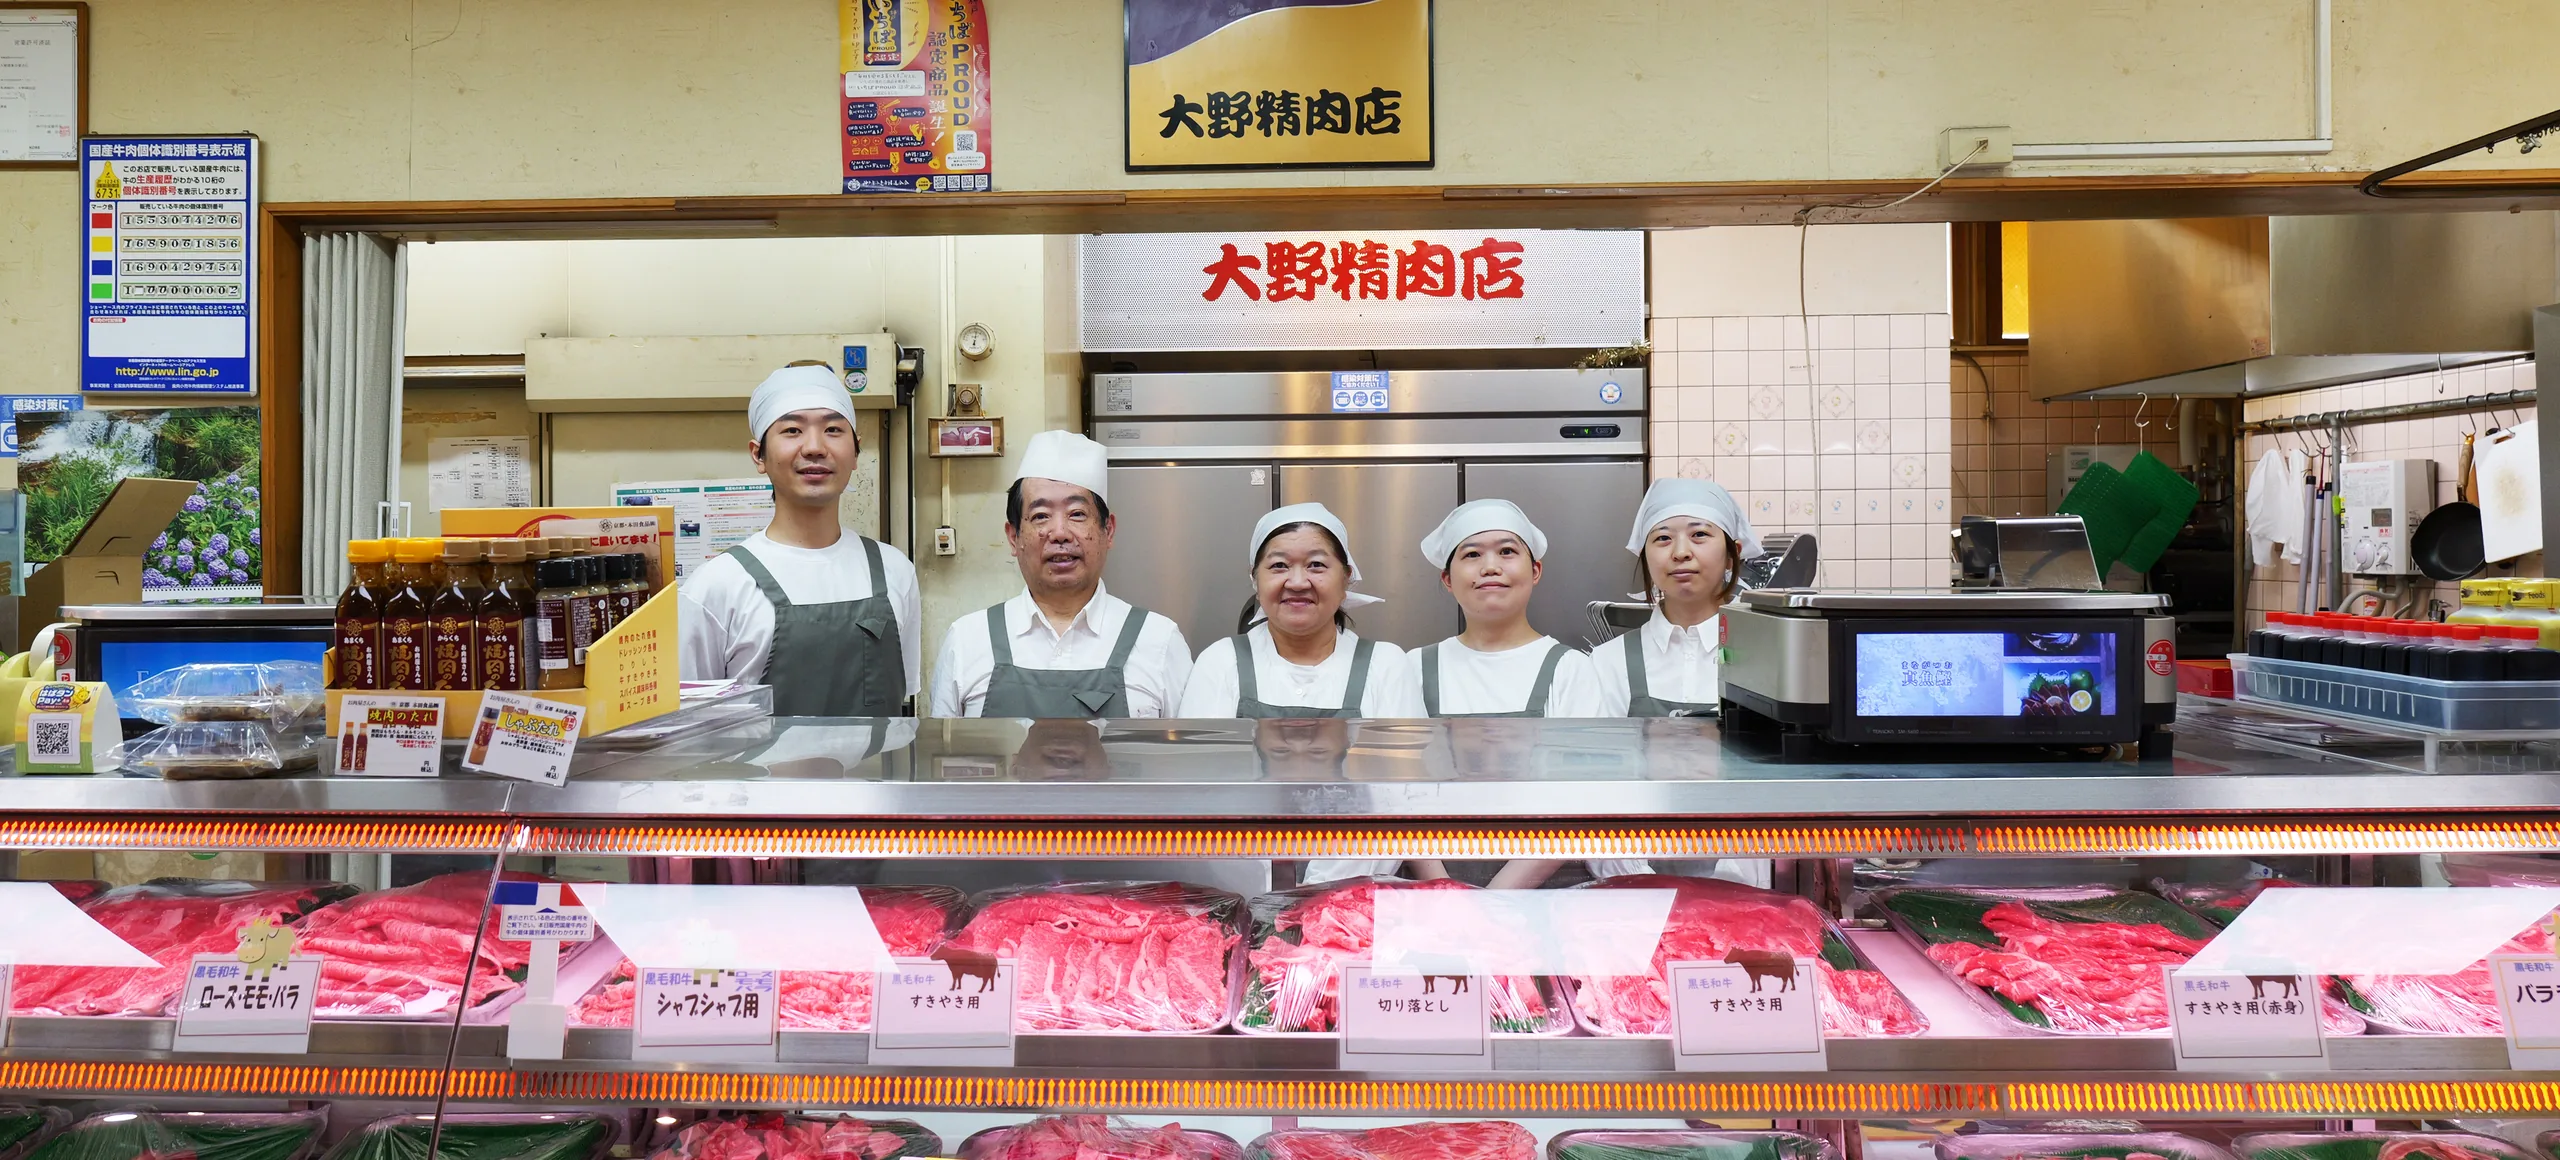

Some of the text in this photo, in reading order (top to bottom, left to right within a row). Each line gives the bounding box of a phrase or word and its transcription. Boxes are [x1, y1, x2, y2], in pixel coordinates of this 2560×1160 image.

[1158, 87, 1402, 139] 大野精肉店
[89, 143, 246, 158] 国産牛肉個体識別番号表示板
[122, 165, 244, 173] このお店で販売している国産牛肉には、
[122, 174, 225, 185] 牛の生産履歴がわかる10桁の
[122, 186, 243, 196] 個体識別番号を表示しております。
[1202, 238, 1525, 302] 大野精肉店
[115, 367, 219, 377] http://www.lin.go.jp
[12, 398, 69, 410] 感染対策に
[344, 636, 364, 644] あまくち
[392, 636, 413, 644] あまくち
[437, 634, 460, 642] からくち
[485, 634, 508, 642] からくち
[365, 646, 373, 684] お肉屋さんの
[460, 644, 468, 683] お肉屋さんの
[508, 644, 516, 683] お肉屋さんの
[1901, 660, 1953, 670] まながつお
[368, 708, 434, 723] 焼肉のたれ
[504, 713, 561, 737] しゃぶたれ
[194, 965, 240, 979] 黒毛和牛
[2513, 961, 2555, 972] 黒毛和牛
[645, 972, 693, 986] 黒毛和牛
[735, 970, 773, 978] ロース
[892, 973, 936, 985] 黒毛和牛
[1358, 977, 1403, 989] 黒毛和牛
[1688, 977, 1733, 990] 黒毛和牛
[2184, 980, 2231, 992] 黒毛和牛
[200, 984, 300, 1010] ロース・モモ・バラ
[2516, 983, 2560, 1003] バラ
[657, 992, 759, 1019] シャブシャブ用
[910, 994, 980, 1010] すきやき用
[1377, 998, 1450, 1013] 切り落とし
[1709, 997, 1783, 1013] すきやき用
[2184, 1000, 2305, 1016] すきやき用(赤身)
